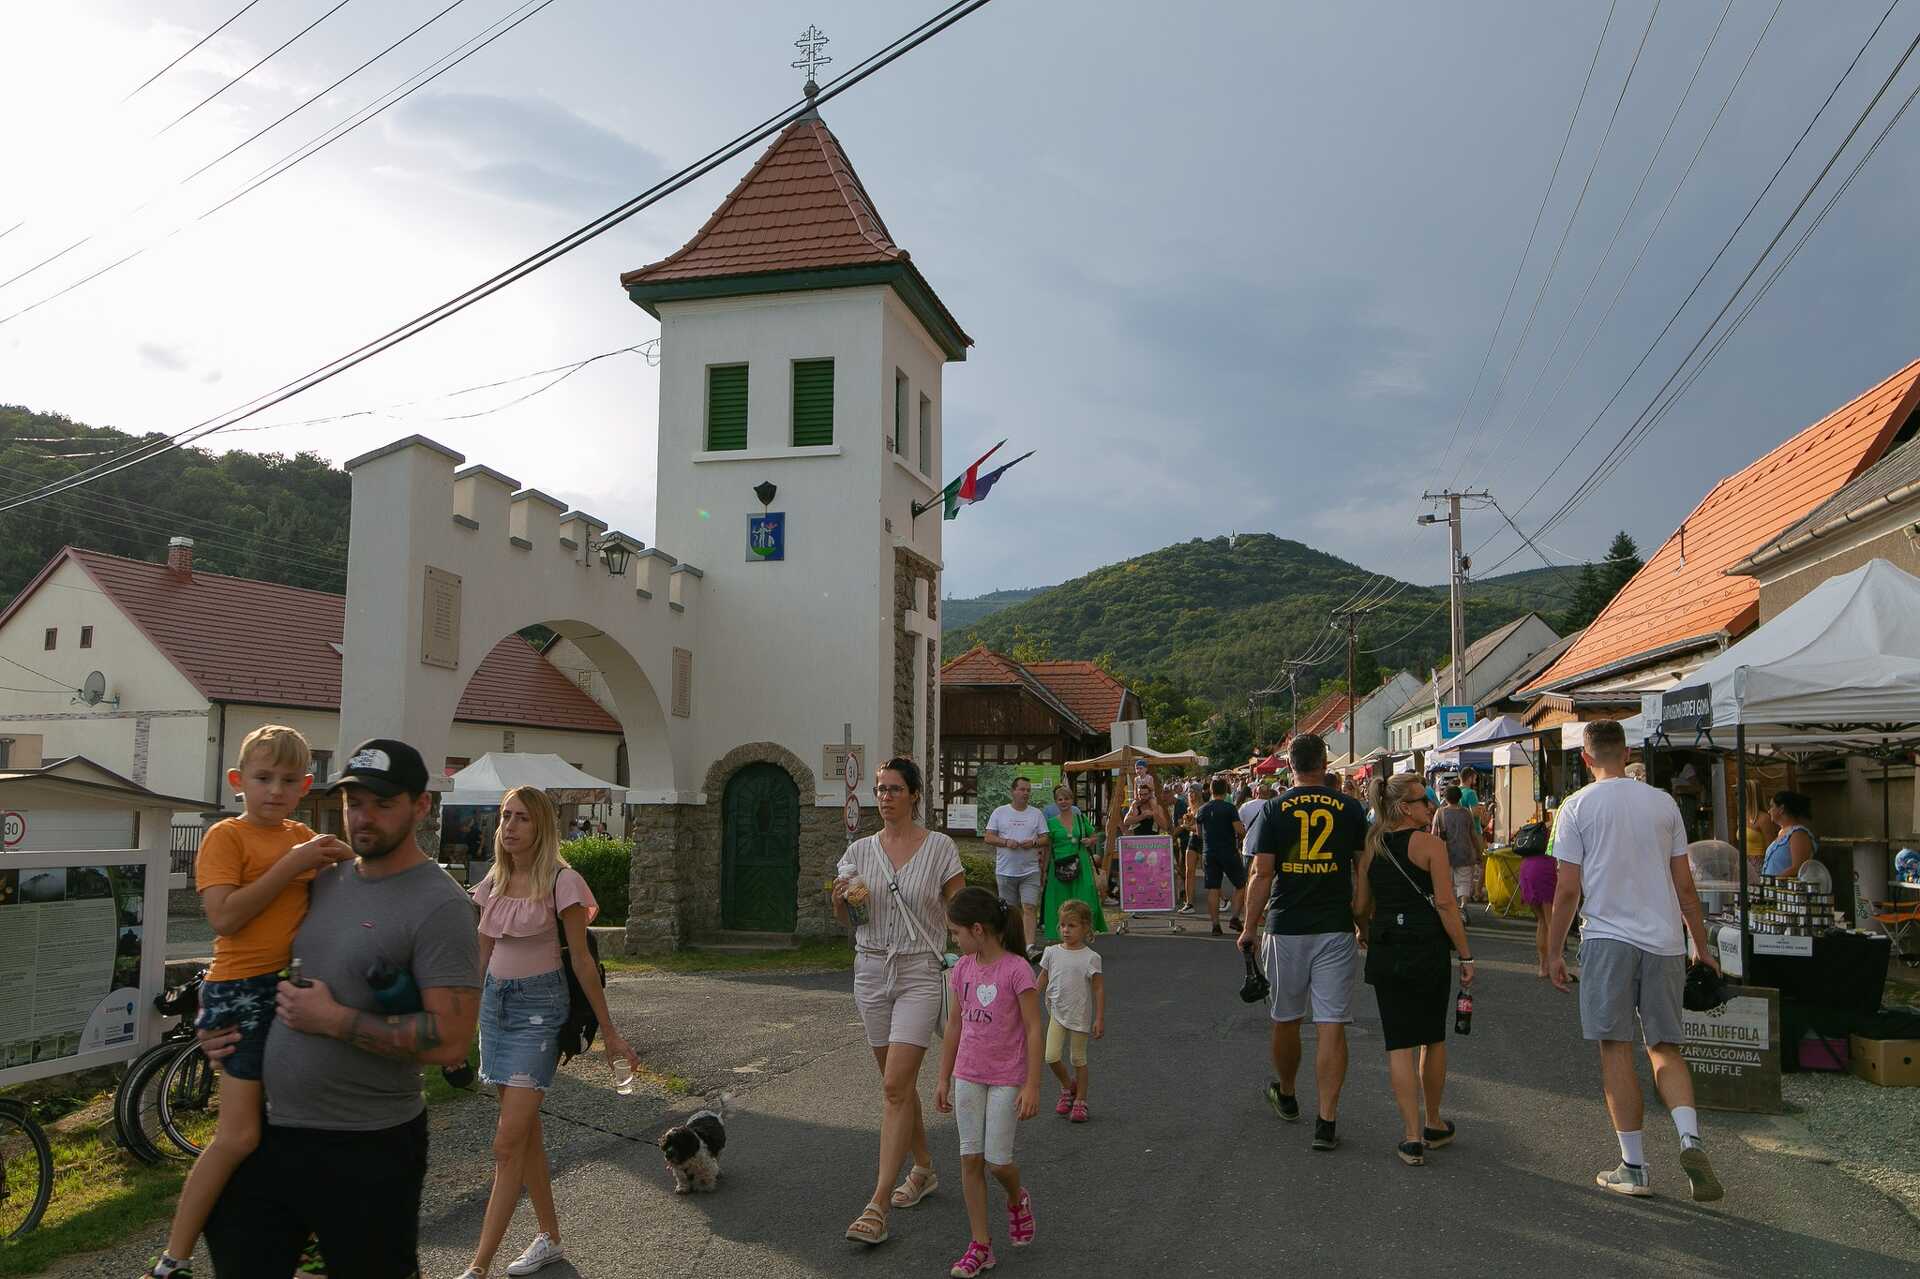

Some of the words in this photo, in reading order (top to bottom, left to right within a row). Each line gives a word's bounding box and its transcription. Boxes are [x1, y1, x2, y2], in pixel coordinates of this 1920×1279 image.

[1281, 794, 1345, 811] AYRTON
[5, 822, 18, 835] 30
[1293, 808, 1334, 860] 12
[1281, 862, 1338, 874] SENNA
[962, 1008, 993, 1024] ATS
[1682, 1022, 1708, 1037] RRA
[1711, 1024, 1760, 1041] TUFFOLA
[1679, 1045, 1761, 1063] ZARVASGOMBA
[1690, 1063, 1743, 1077] TRUFFLE
